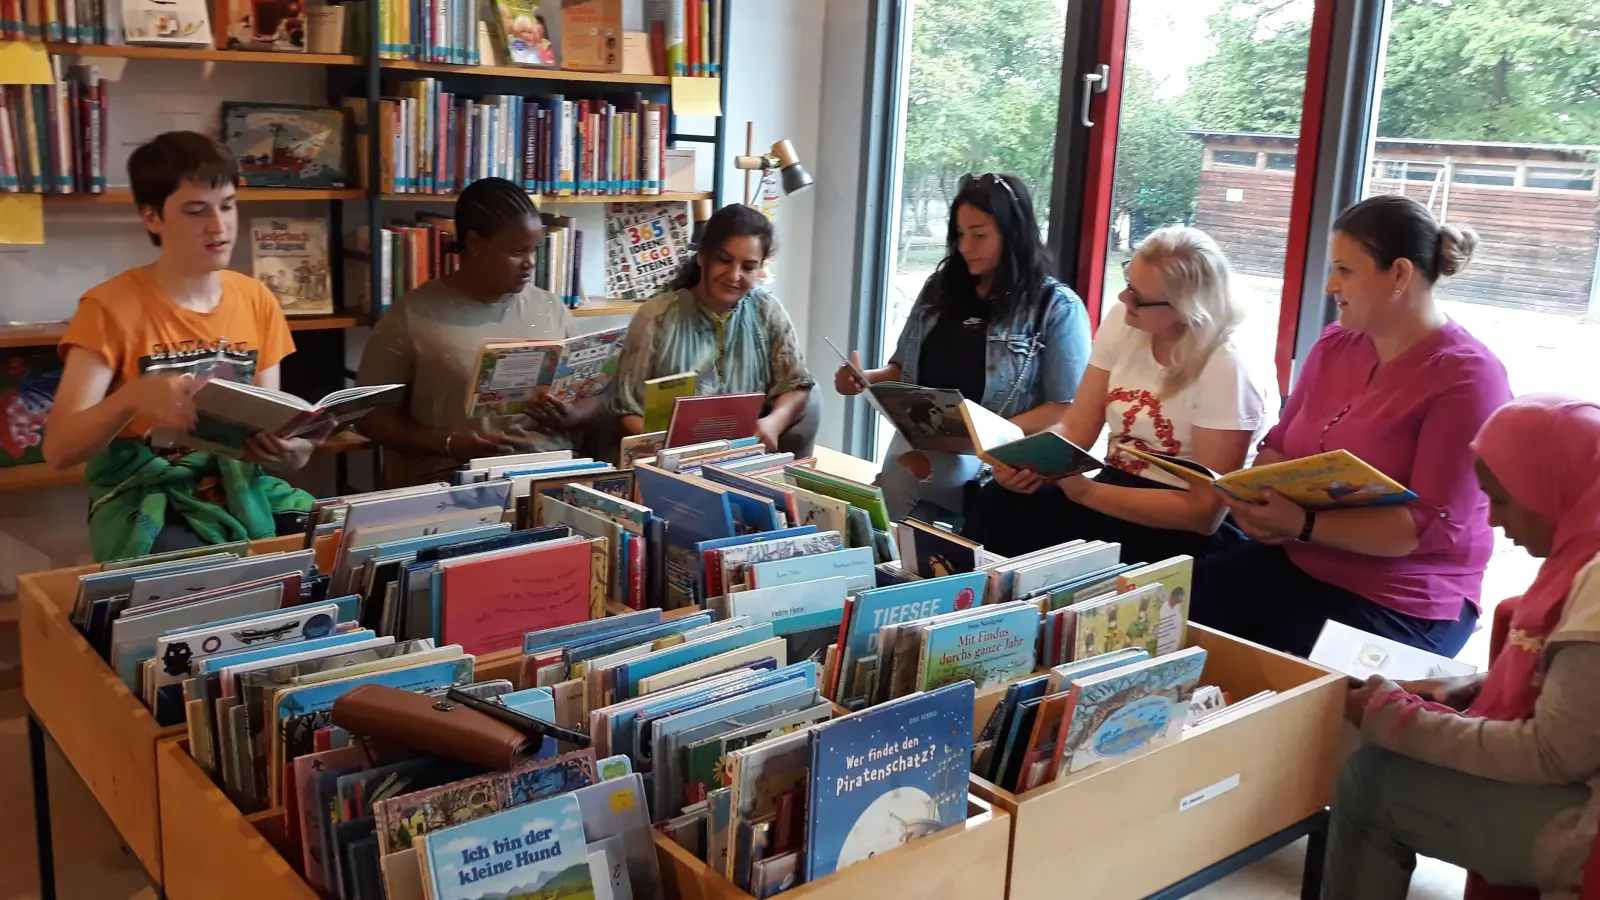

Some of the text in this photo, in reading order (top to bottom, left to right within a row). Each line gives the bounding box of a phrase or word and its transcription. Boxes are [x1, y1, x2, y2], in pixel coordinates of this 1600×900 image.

[628, 220, 665, 245] 365
[629, 239, 660, 255] IDEEN
[632, 246, 671, 265] LEGO
[636, 256, 675, 275] STEINE
[873, 598, 943, 629] TIEFSEE
[939, 648, 972, 666] durchs
[974, 643, 1002, 660] ganze
[1004, 635, 1024, 650] Jahr
[957, 627, 1010, 649] Mit Findus
[846, 735, 920, 770] Wer findet den
[835, 743, 937, 797] Piratenschatz?
[461, 826, 553, 866] Ich bin der
[457, 841, 562, 887] kleine Hund
